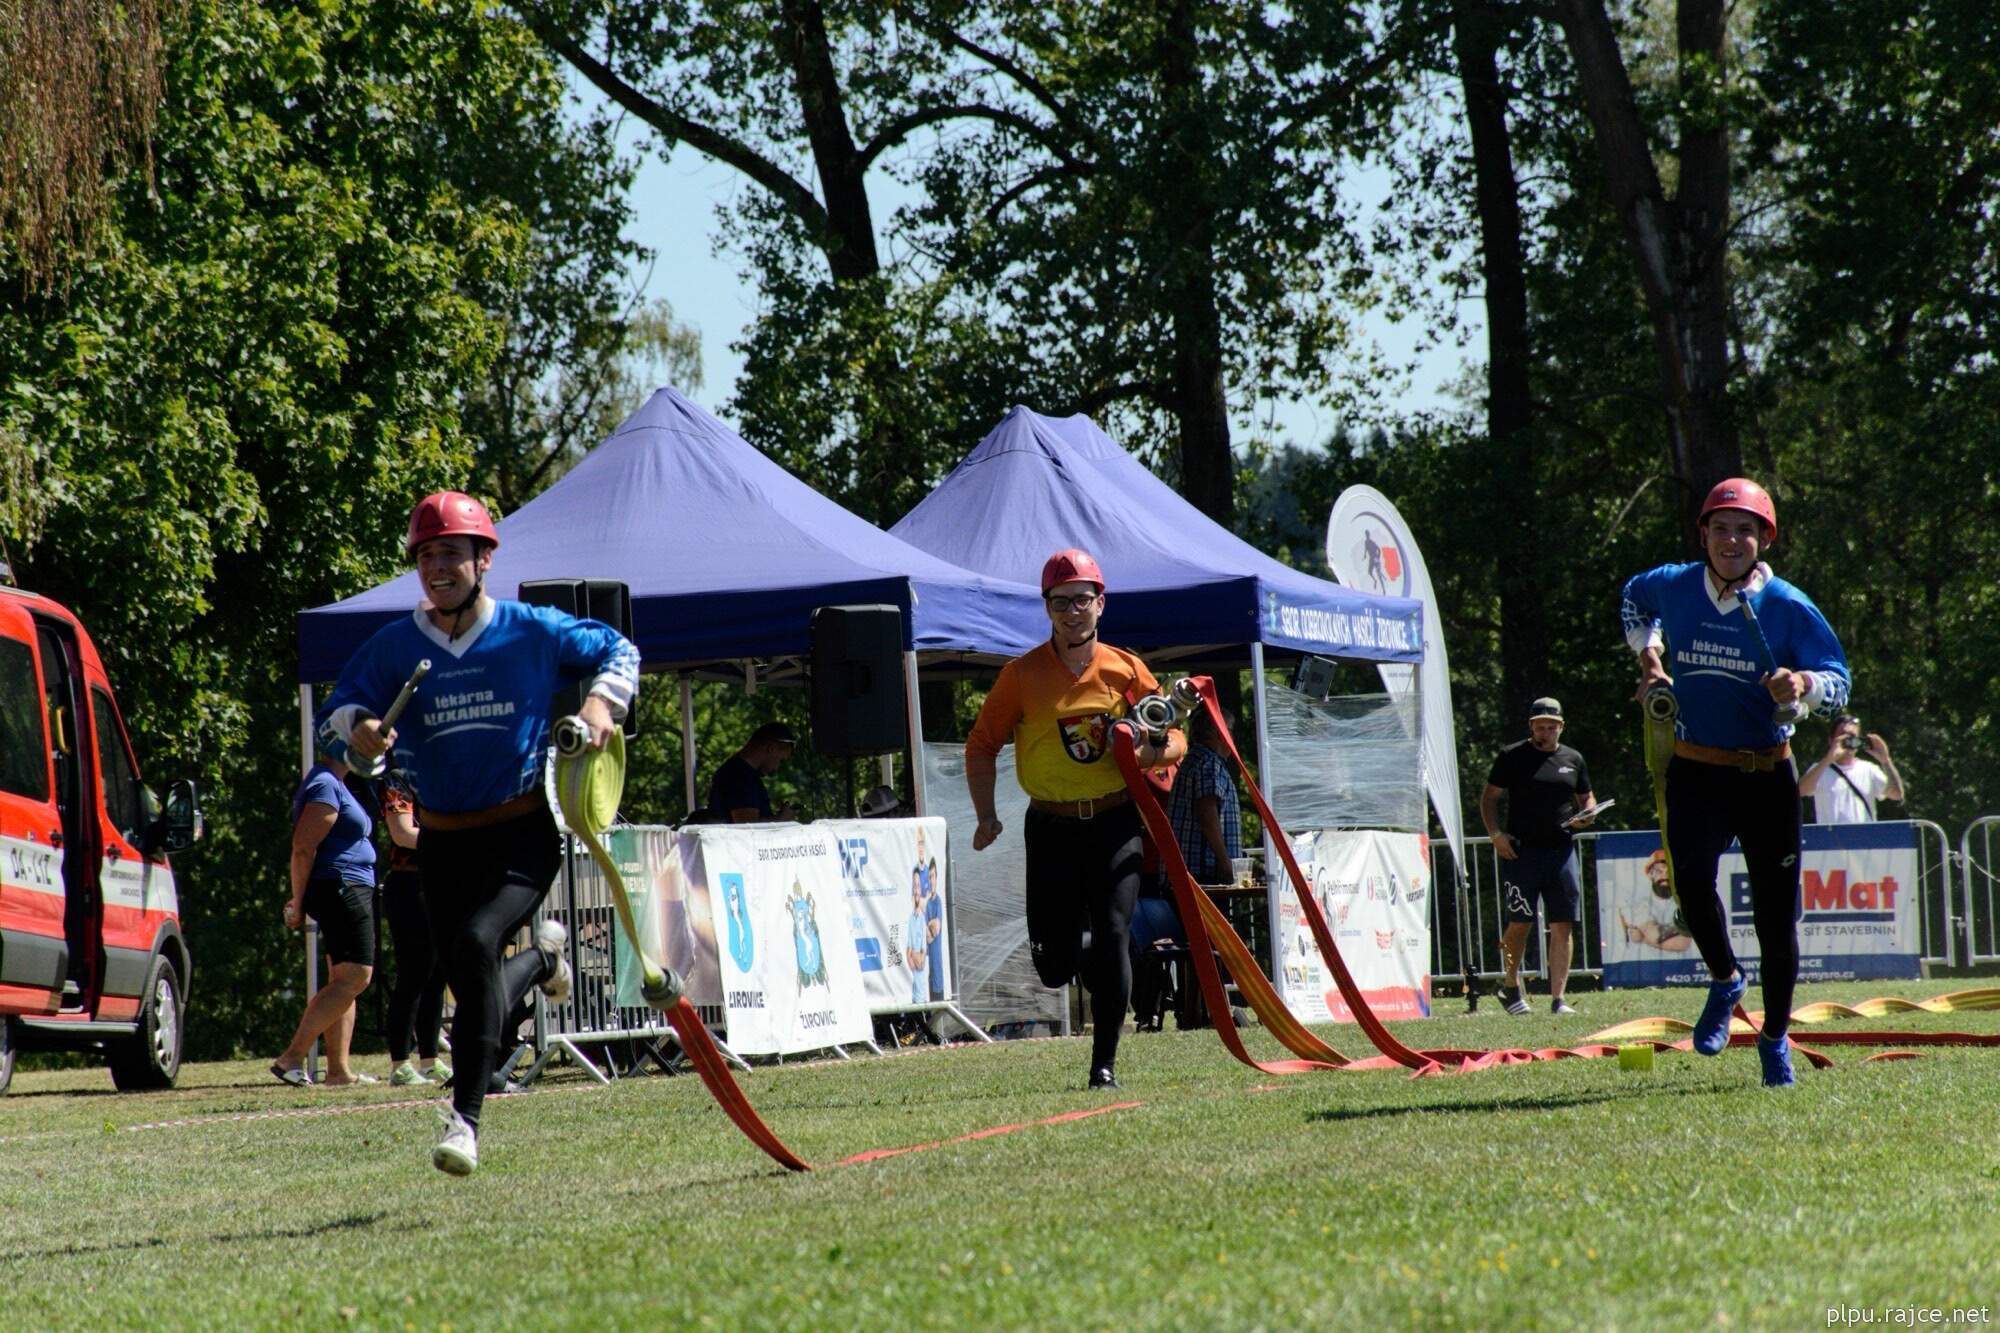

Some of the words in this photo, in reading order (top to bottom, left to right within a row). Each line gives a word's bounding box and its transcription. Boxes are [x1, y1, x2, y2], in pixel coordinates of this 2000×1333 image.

[1281, 604, 1302, 640] SBOR
[1692, 639, 1741, 657] lékárna
[1677, 651, 1756, 672] ALEXANDRA
[435, 690, 494, 709] lékárna
[424, 702, 515, 726] ALEXANDRA
[1730, 870, 1898, 921] BMat
[1824, 925, 1896, 936] STAVEBNIN
[1665, 974, 1691, 983] +420
